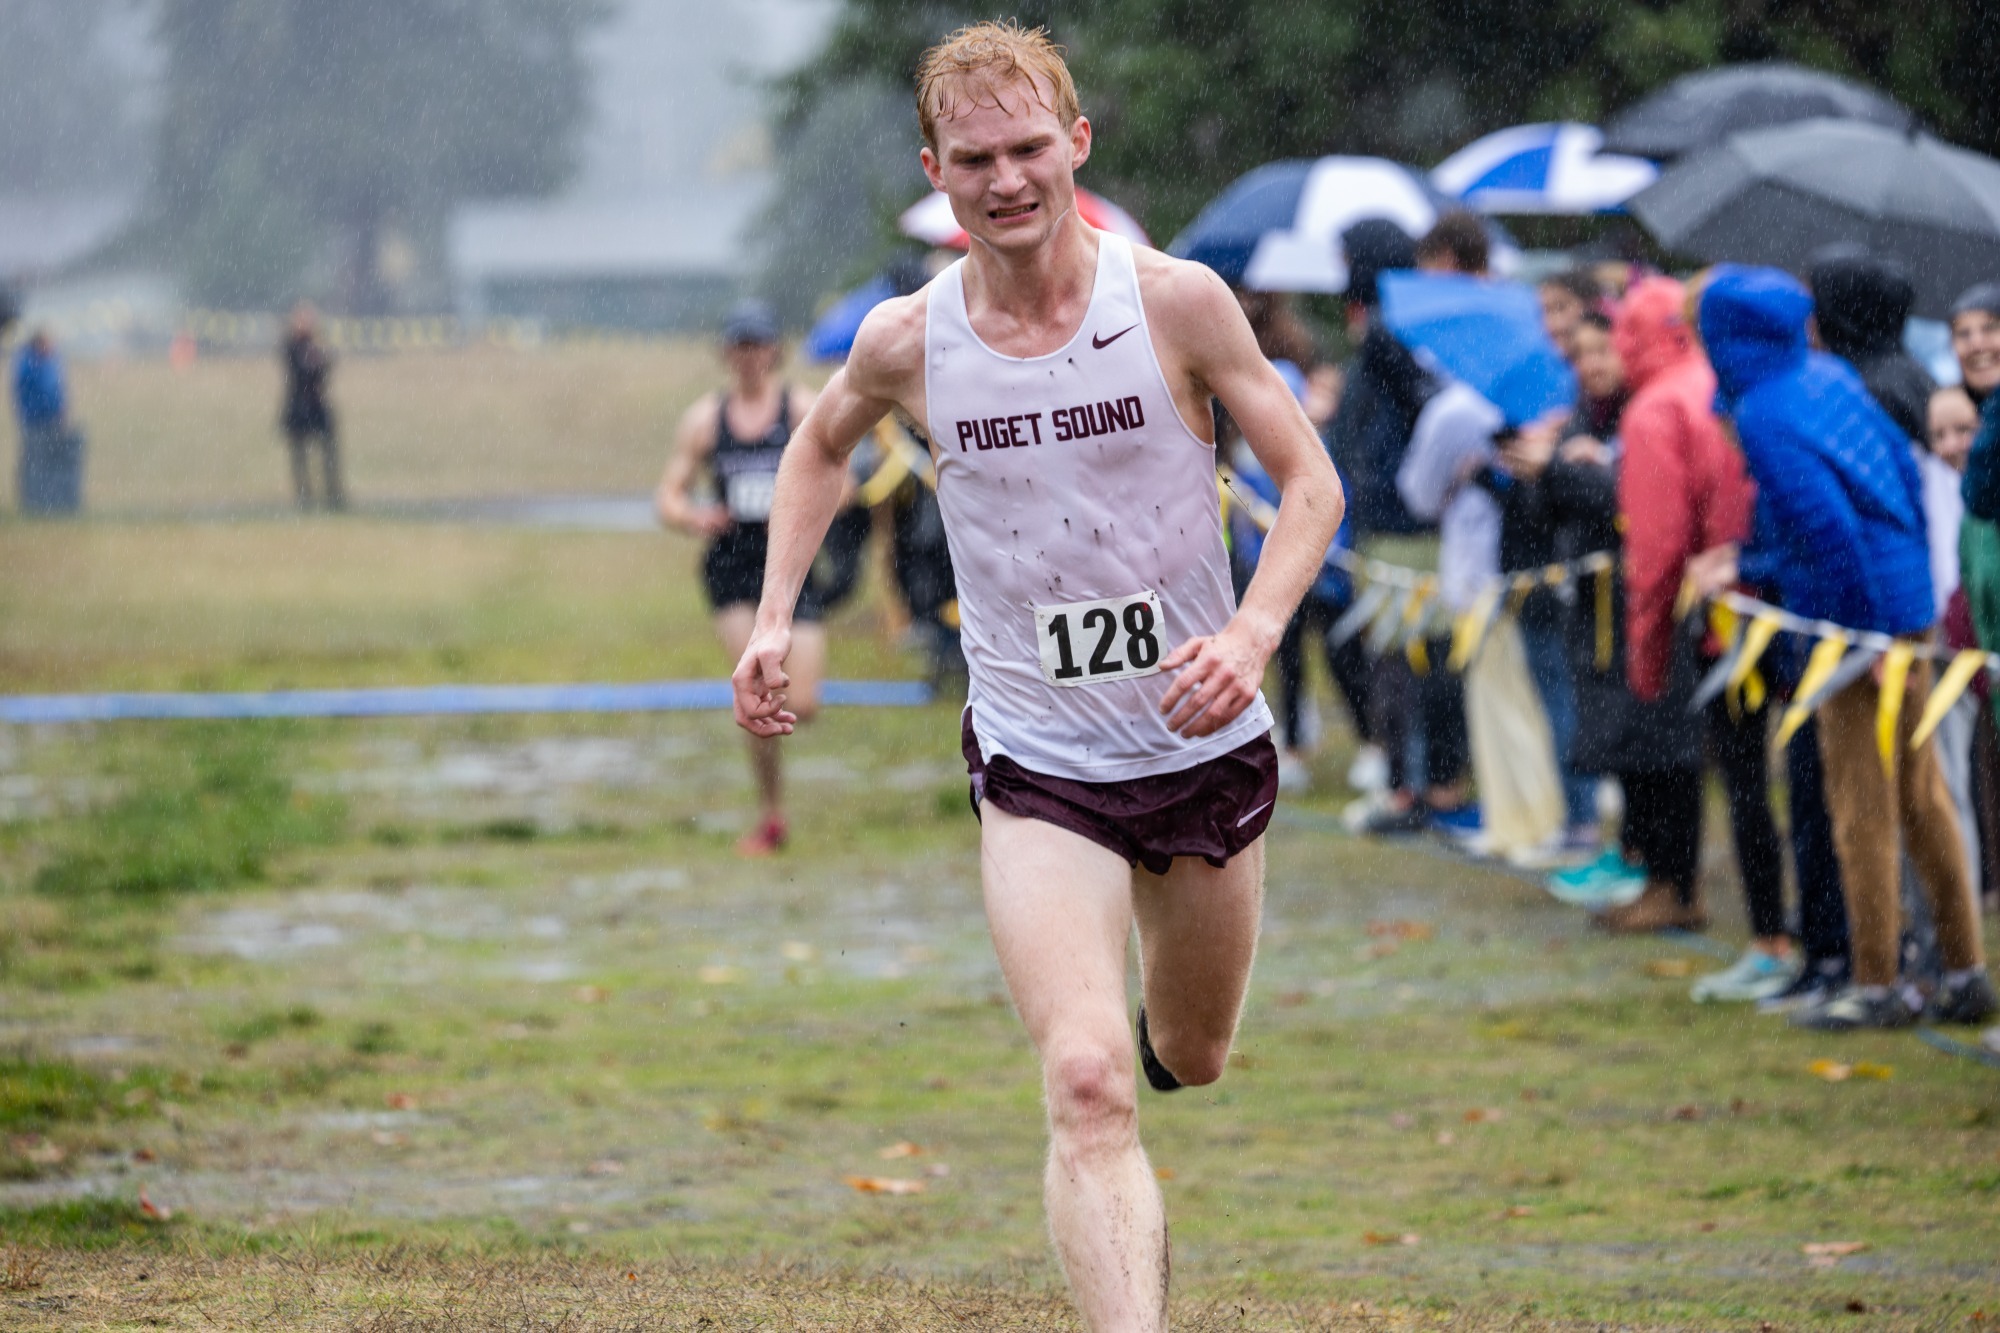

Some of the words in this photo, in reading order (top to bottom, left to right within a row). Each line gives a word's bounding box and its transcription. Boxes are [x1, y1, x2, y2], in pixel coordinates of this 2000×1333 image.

[956, 412, 1042, 452] PUGET
[1052, 395, 1145, 442] SOUND
[1048, 602, 1159, 679] 128
